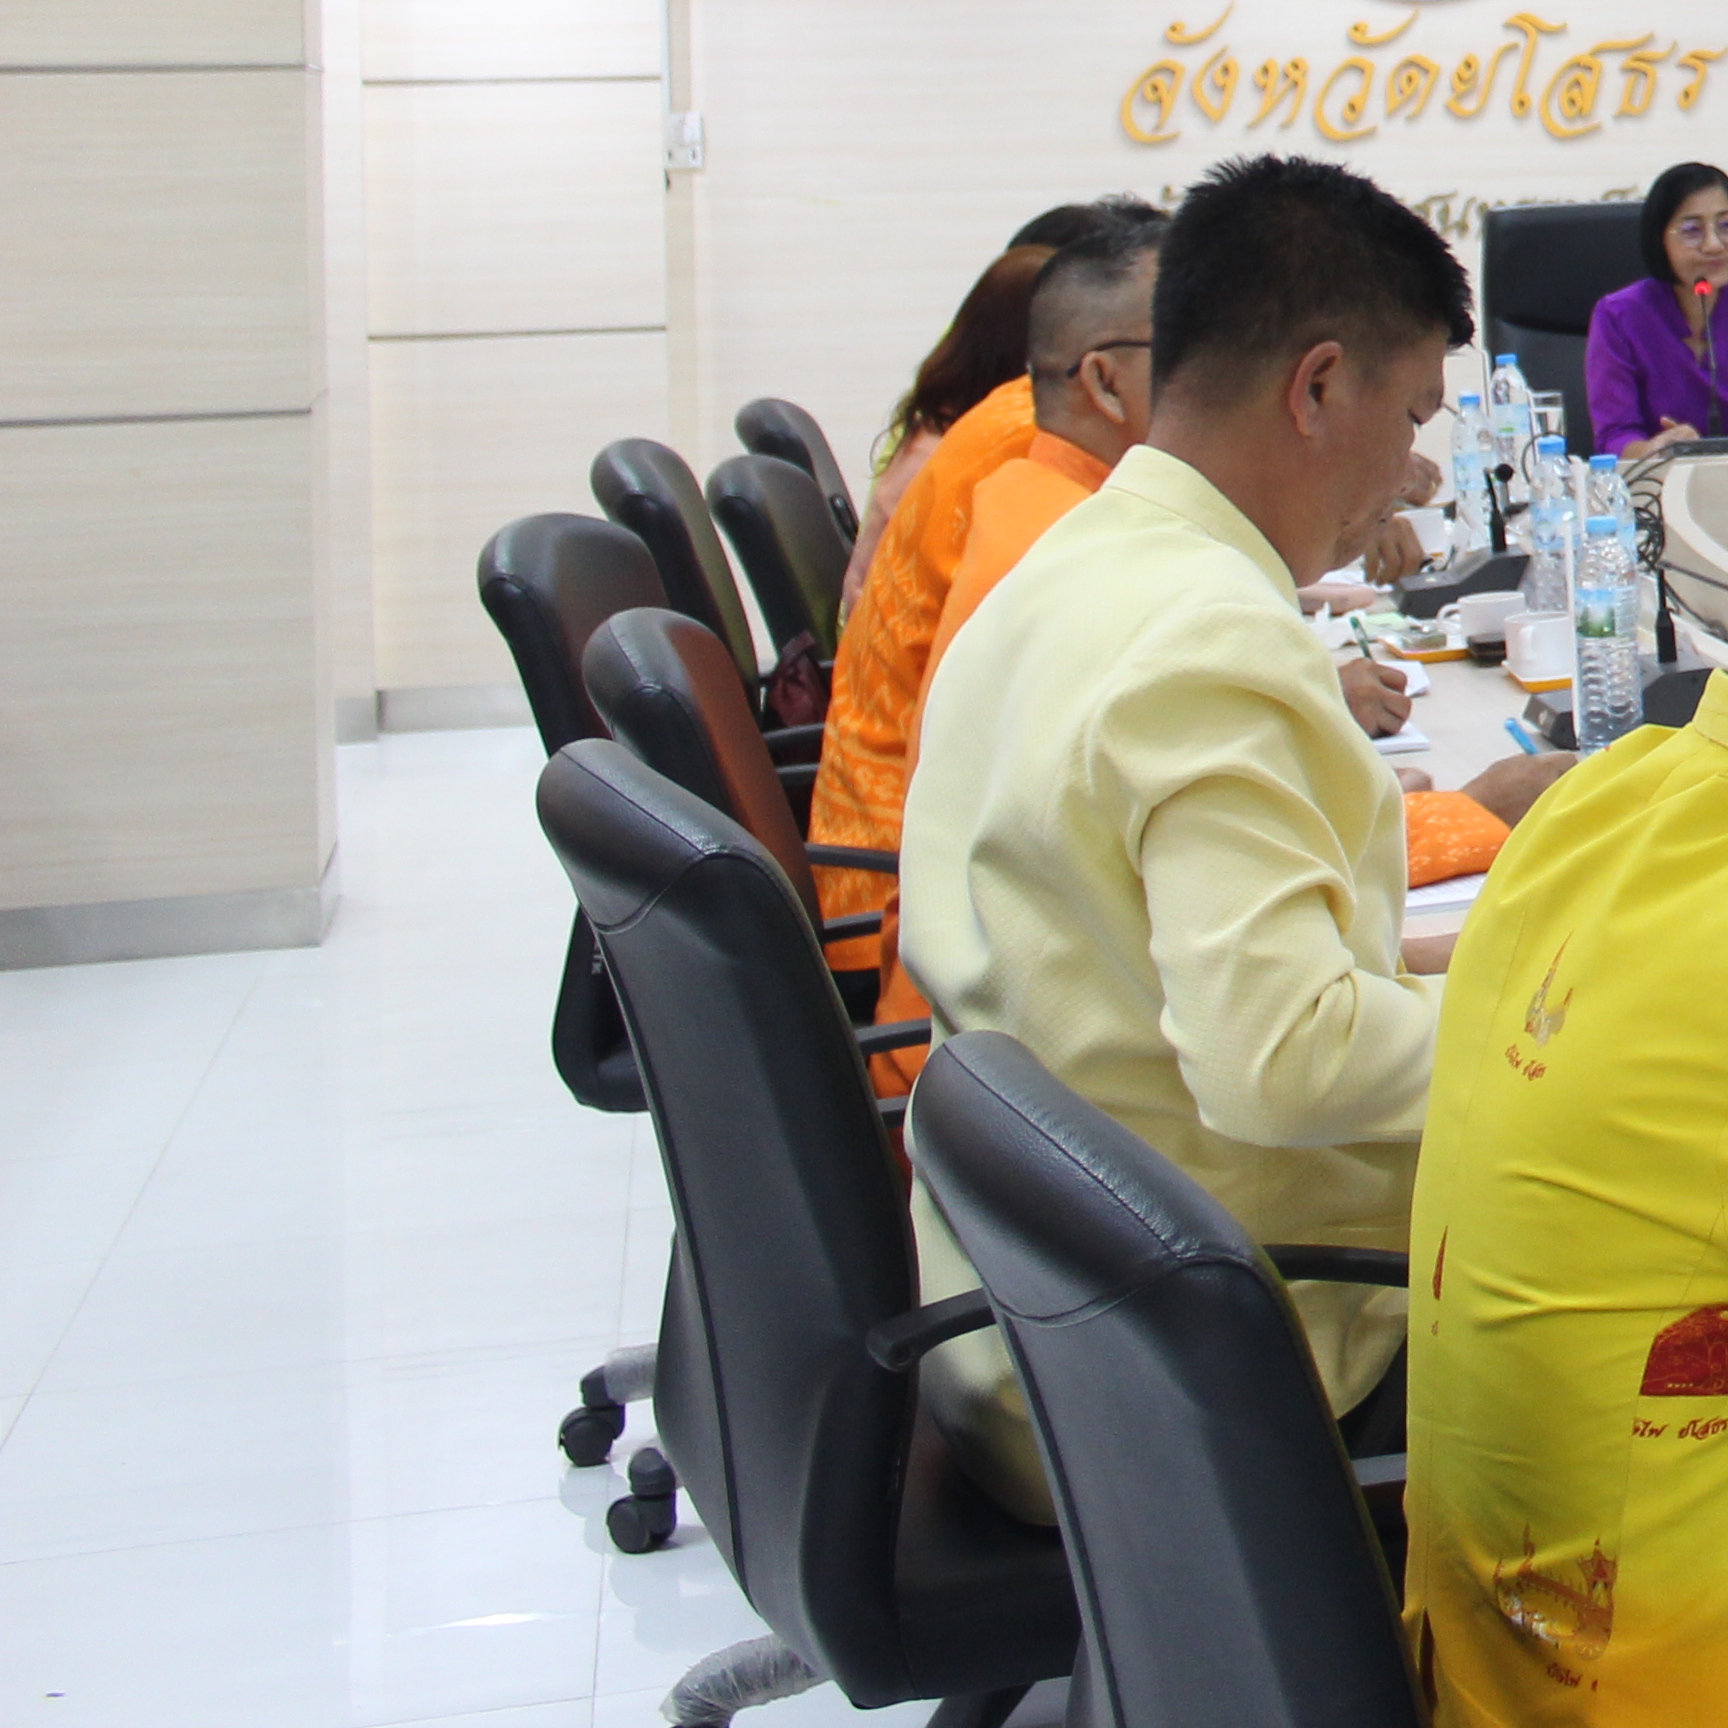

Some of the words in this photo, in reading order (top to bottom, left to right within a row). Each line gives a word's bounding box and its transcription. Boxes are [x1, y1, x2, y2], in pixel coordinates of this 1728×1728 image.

[1119, 0, 1728, 144] จังหวัดยโสธร
